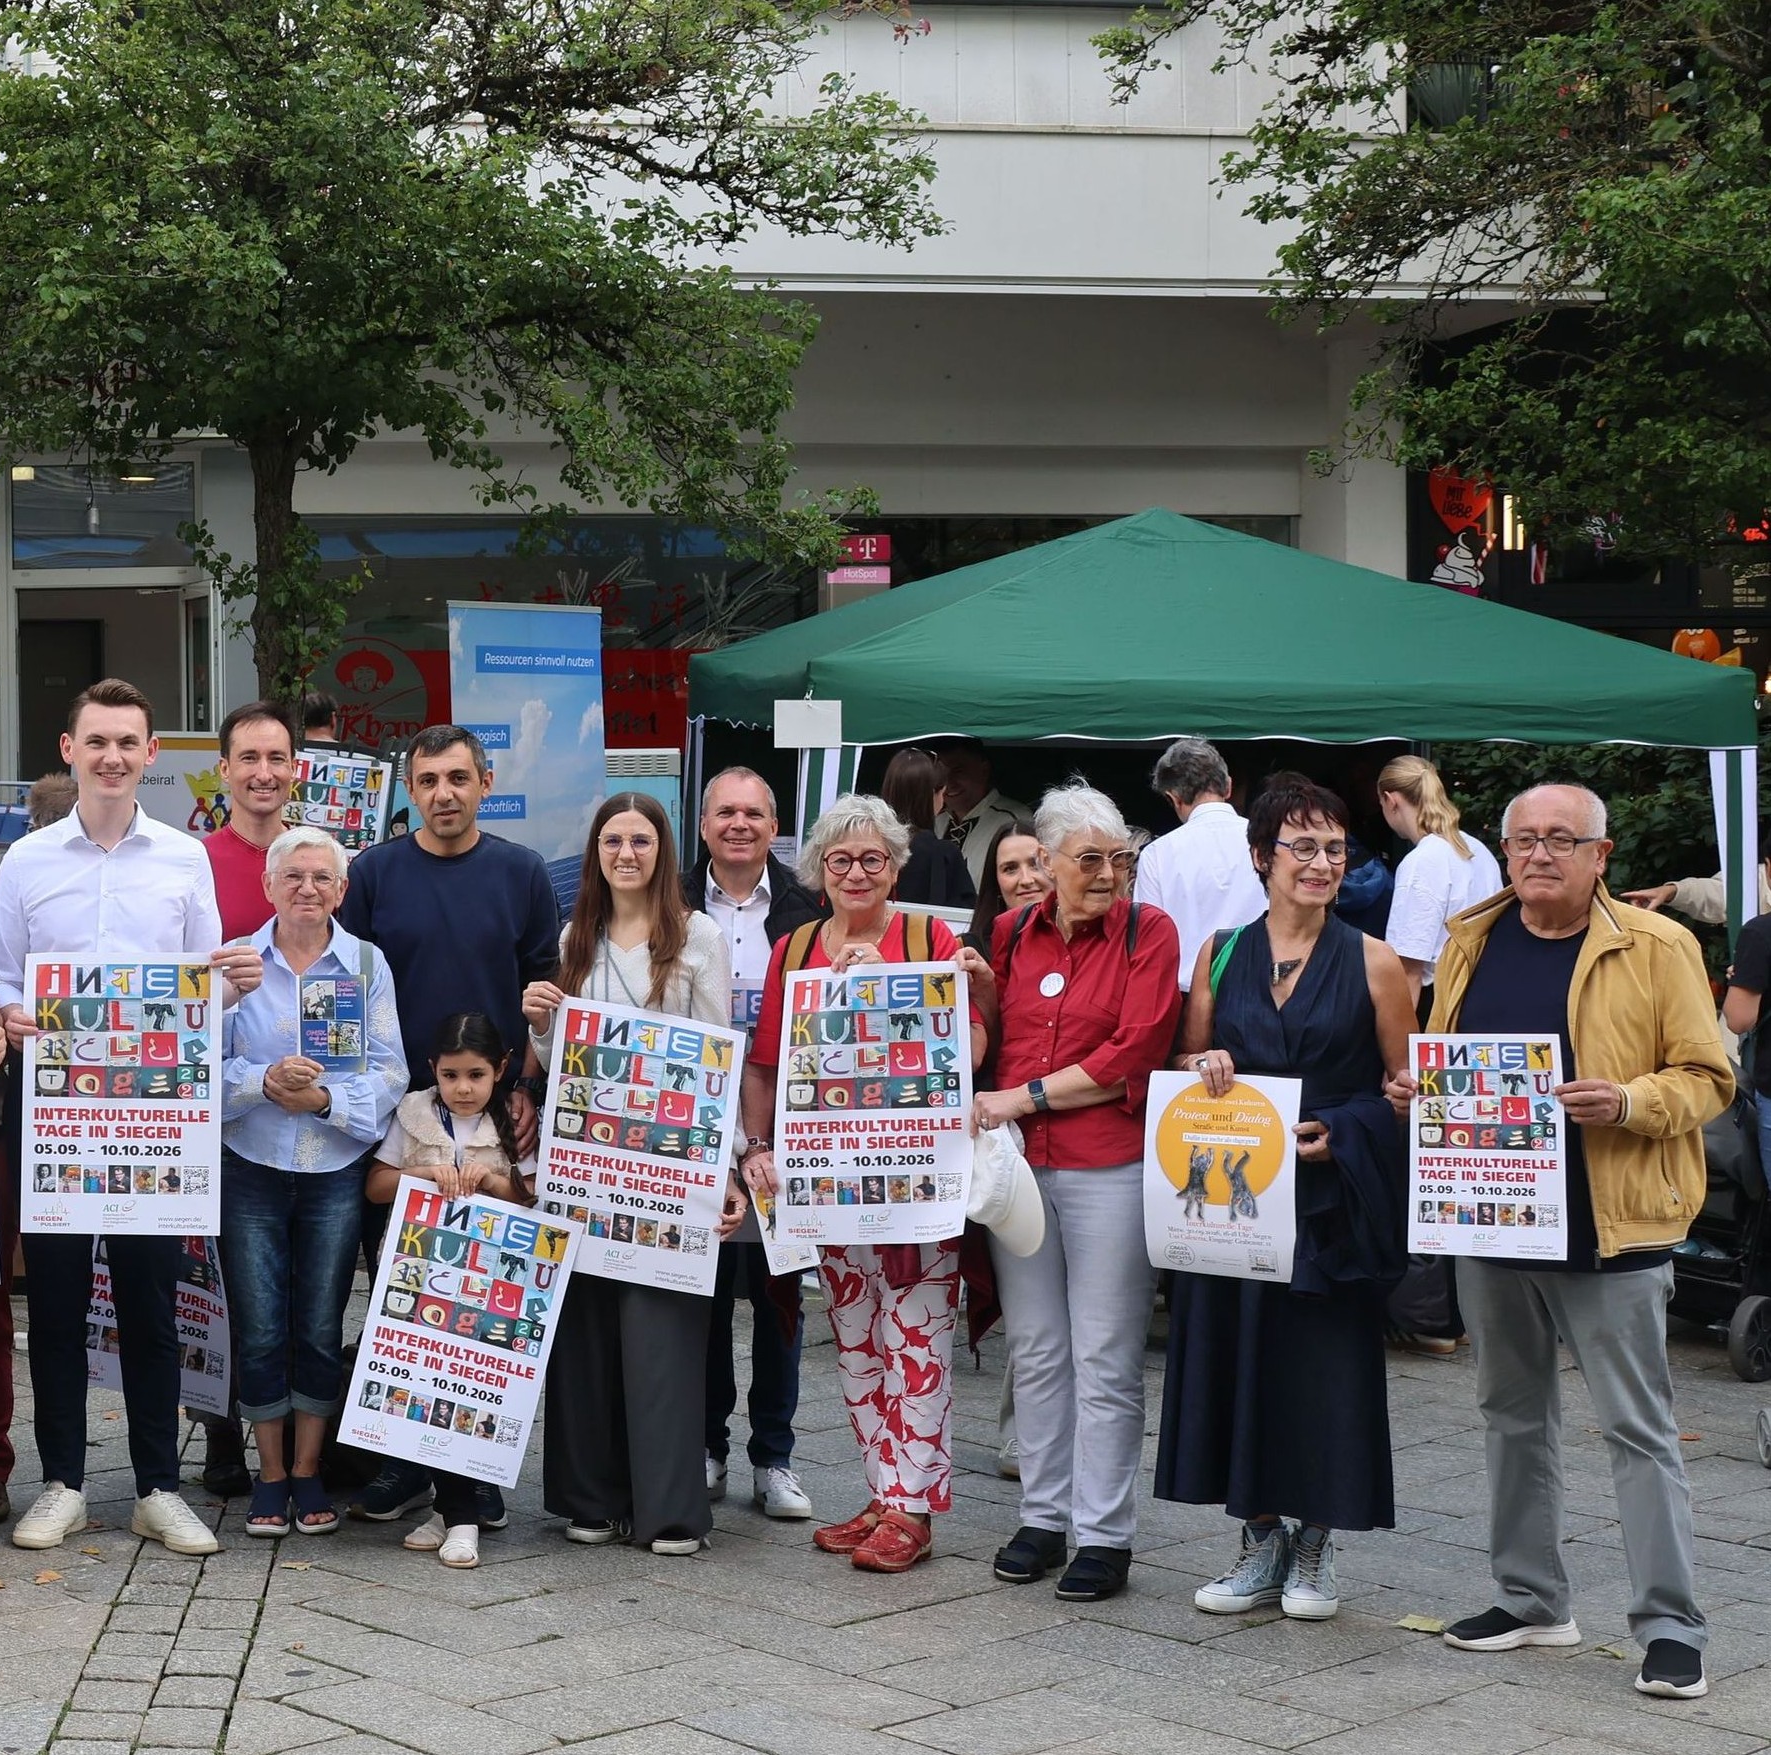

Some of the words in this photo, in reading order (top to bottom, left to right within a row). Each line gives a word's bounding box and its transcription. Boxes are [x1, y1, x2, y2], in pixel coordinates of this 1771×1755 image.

[843, 568, 877, 579] HotSpot
[484, 652, 532, 666] Ressourcen
[534, 653, 565, 667] sinnvoll
[567, 655, 594, 668] nutzen
[477, 729, 507, 743] logisch
[137, 774, 175, 785] sbeirat
[477, 800, 521, 814] schaftlich
[34, 1108, 210, 1122] INTERKULTURELLE
[1173, 1108, 1209, 1121] Protest
[1212, 1112, 1233, 1122] und
[1234, 1112, 1271, 1126] Dialog
[33, 1124, 82, 1137] TAGE
[88, 1125, 108, 1138] IN
[114, 1125, 182, 1139] SIEGEN
[785, 1117, 962, 1134] INTERKULTURELLE
[34, 1143, 82, 1155] 05.09.
[100, 1144, 182, 1157] 10.10.2026
[785, 1137, 833, 1151] TAGE
[840, 1137, 860, 1149] IN
[866, 1135, 934, 1149] SIEGEN
[549, 1147, 716, 1187] INTERKULTURELLE
[786, 1156, 834, 1168] 05.09.
[852, 1155, 935, 1166] 10.10.2026
[1418, 1156, 1557, 1169] INTERKULTURELLE
[546, 1162, 593, 1182] TAGE
[598, 1172, 618, 1186] IN
[622, 1176, 688, 1199] SIEGEN
[1418, 1169, 1456, 1180] TAGE
[1461, 1170, 1477, 1181] IN
[1482, 1171, 1535, 1183] SIEGEN
[1419, 1184, 1456, 1194] 05.09.
[1471, 1186, 1536, 1197] 10.10.2026
[545, 1181, 591, 1199] 05.09.
[607, 1192, 685, 1216] 10.10.2026
[375, 1325, 537, 1379] INTERKULTURELLE
[371, 1341, 419, 1365] TAGE
[423, 1355, 443, 1371] IN
[446, 1361, 509, 1389] SIEGEN
[368, 1360, 415, 1382] 05.09.
[429, 1376, 505, 1406] 10.10.2026
